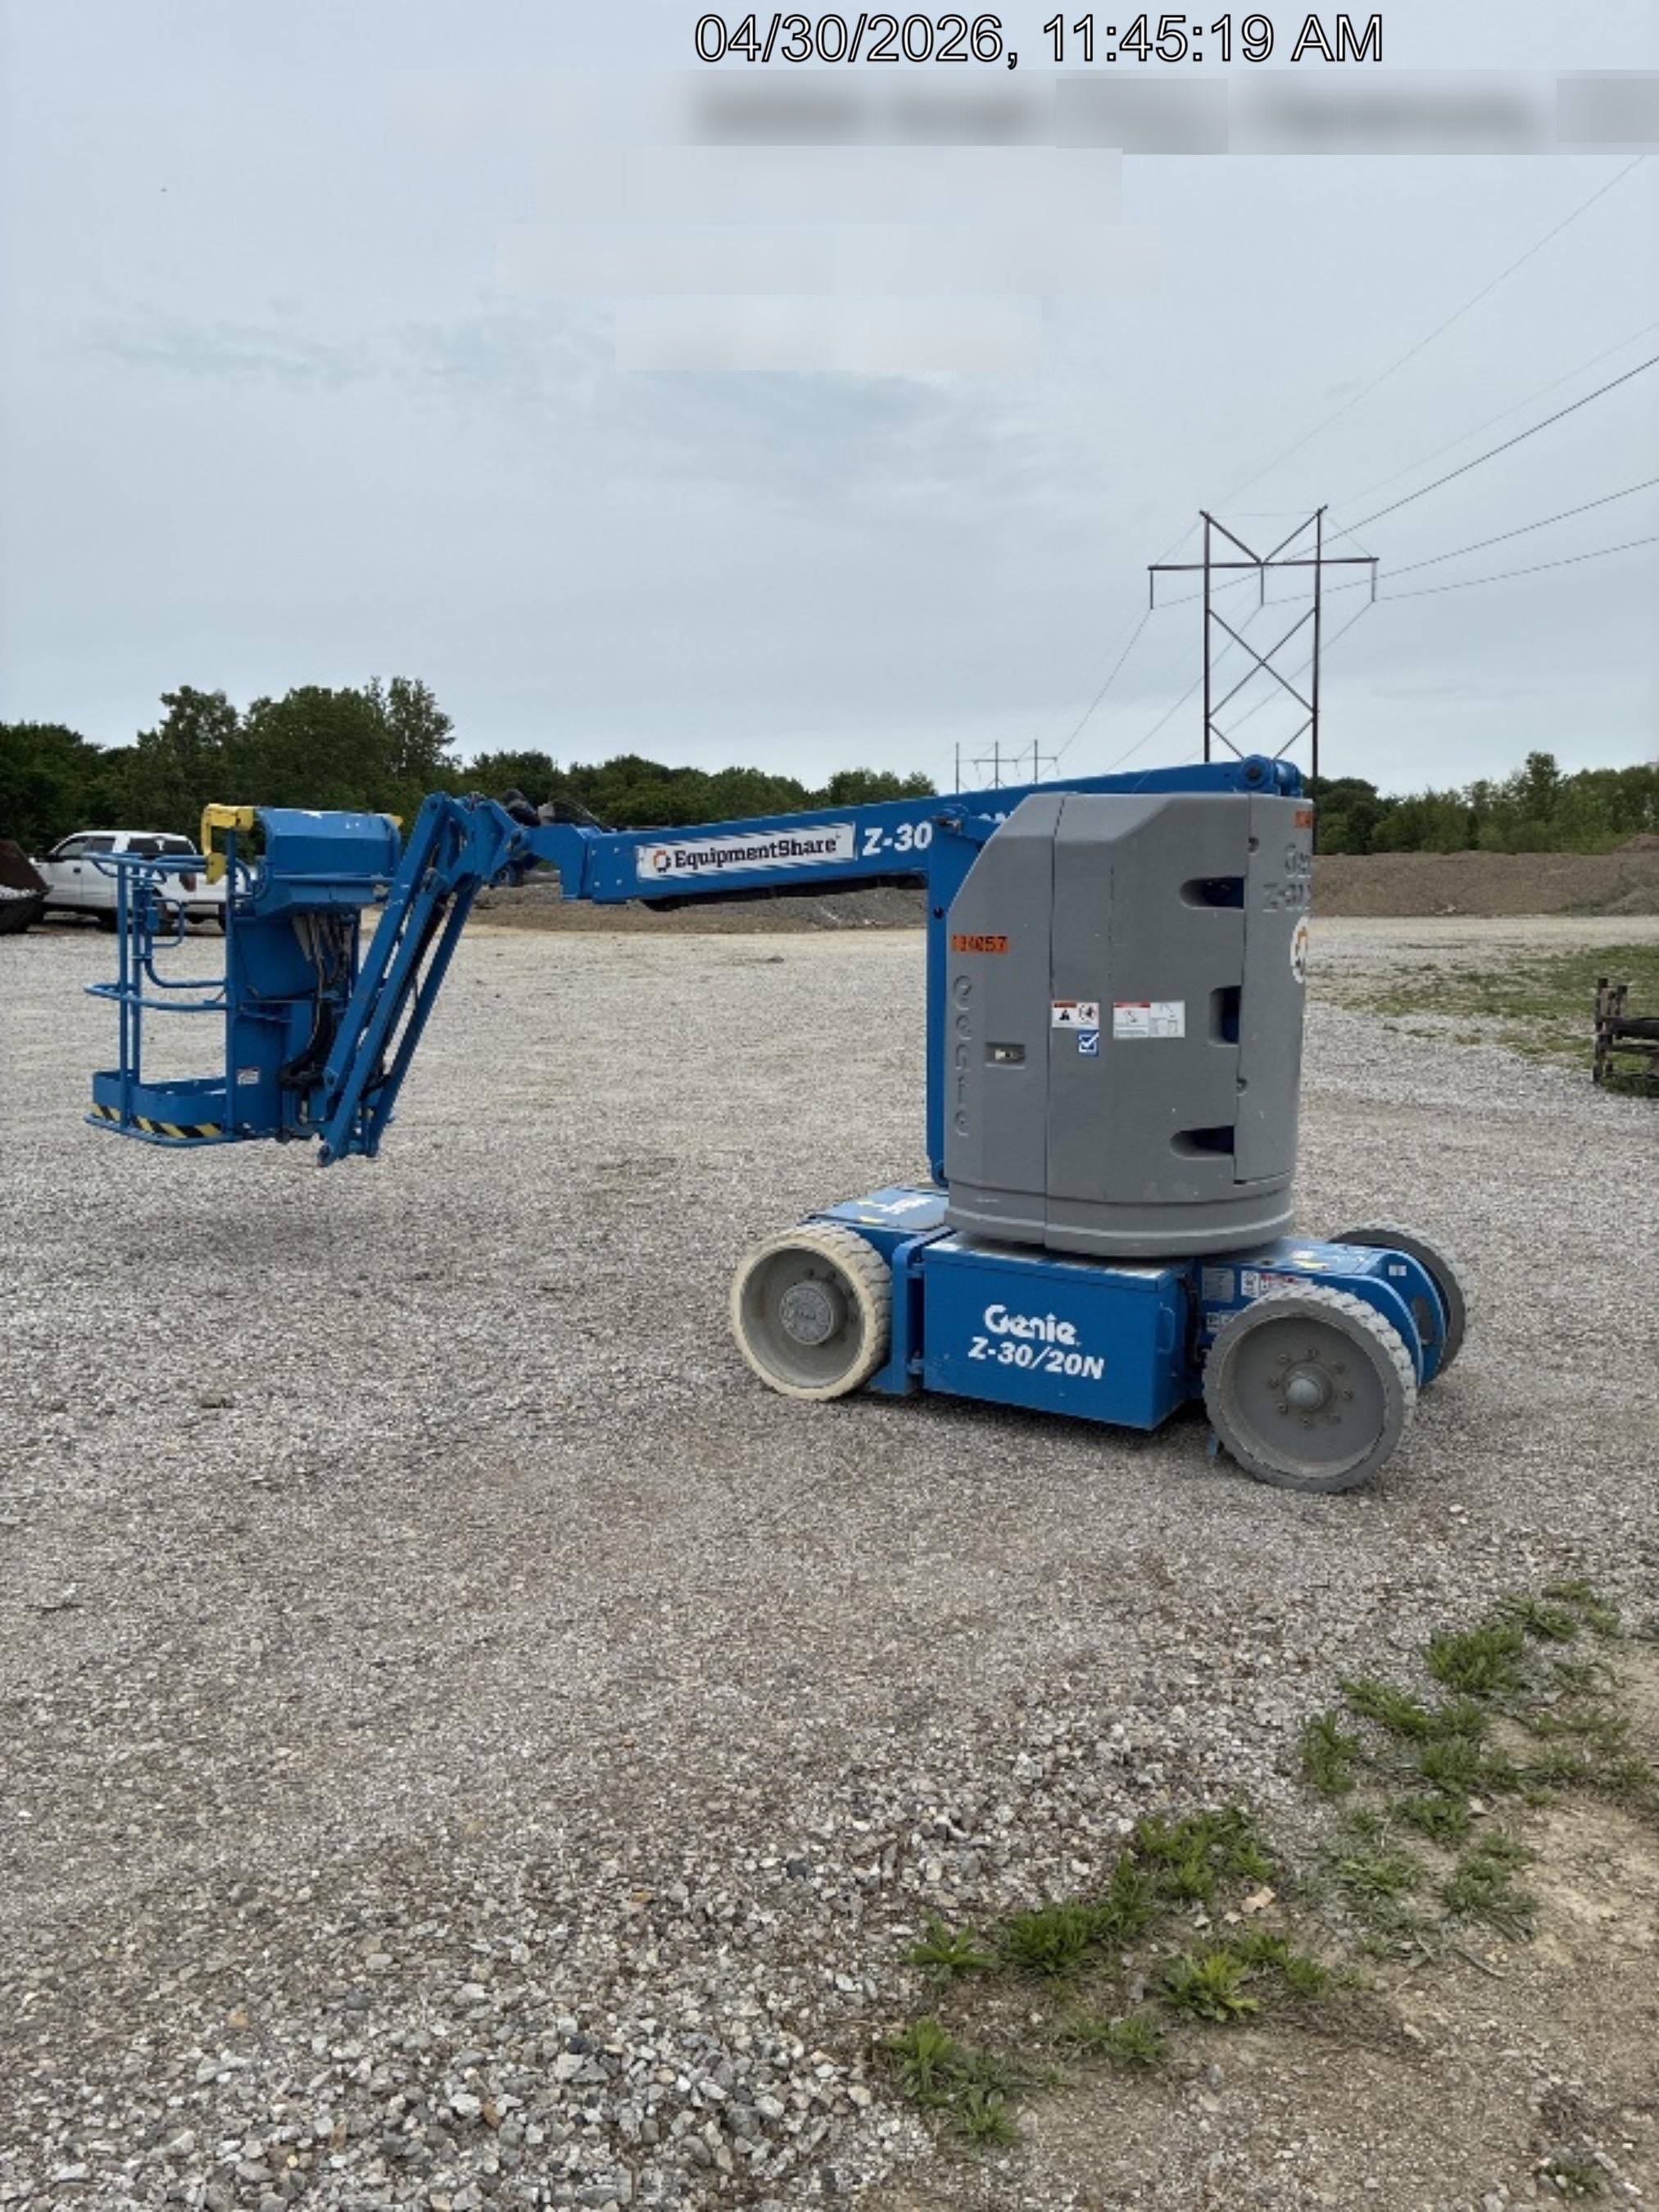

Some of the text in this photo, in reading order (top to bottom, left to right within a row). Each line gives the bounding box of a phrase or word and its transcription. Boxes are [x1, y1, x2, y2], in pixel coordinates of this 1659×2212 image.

[674, 838, 836, 870] EquipmentShare
[985, 1304, 1077, 1345] Genie
[968, 1336, 1104, 1380] Z-30/20N
